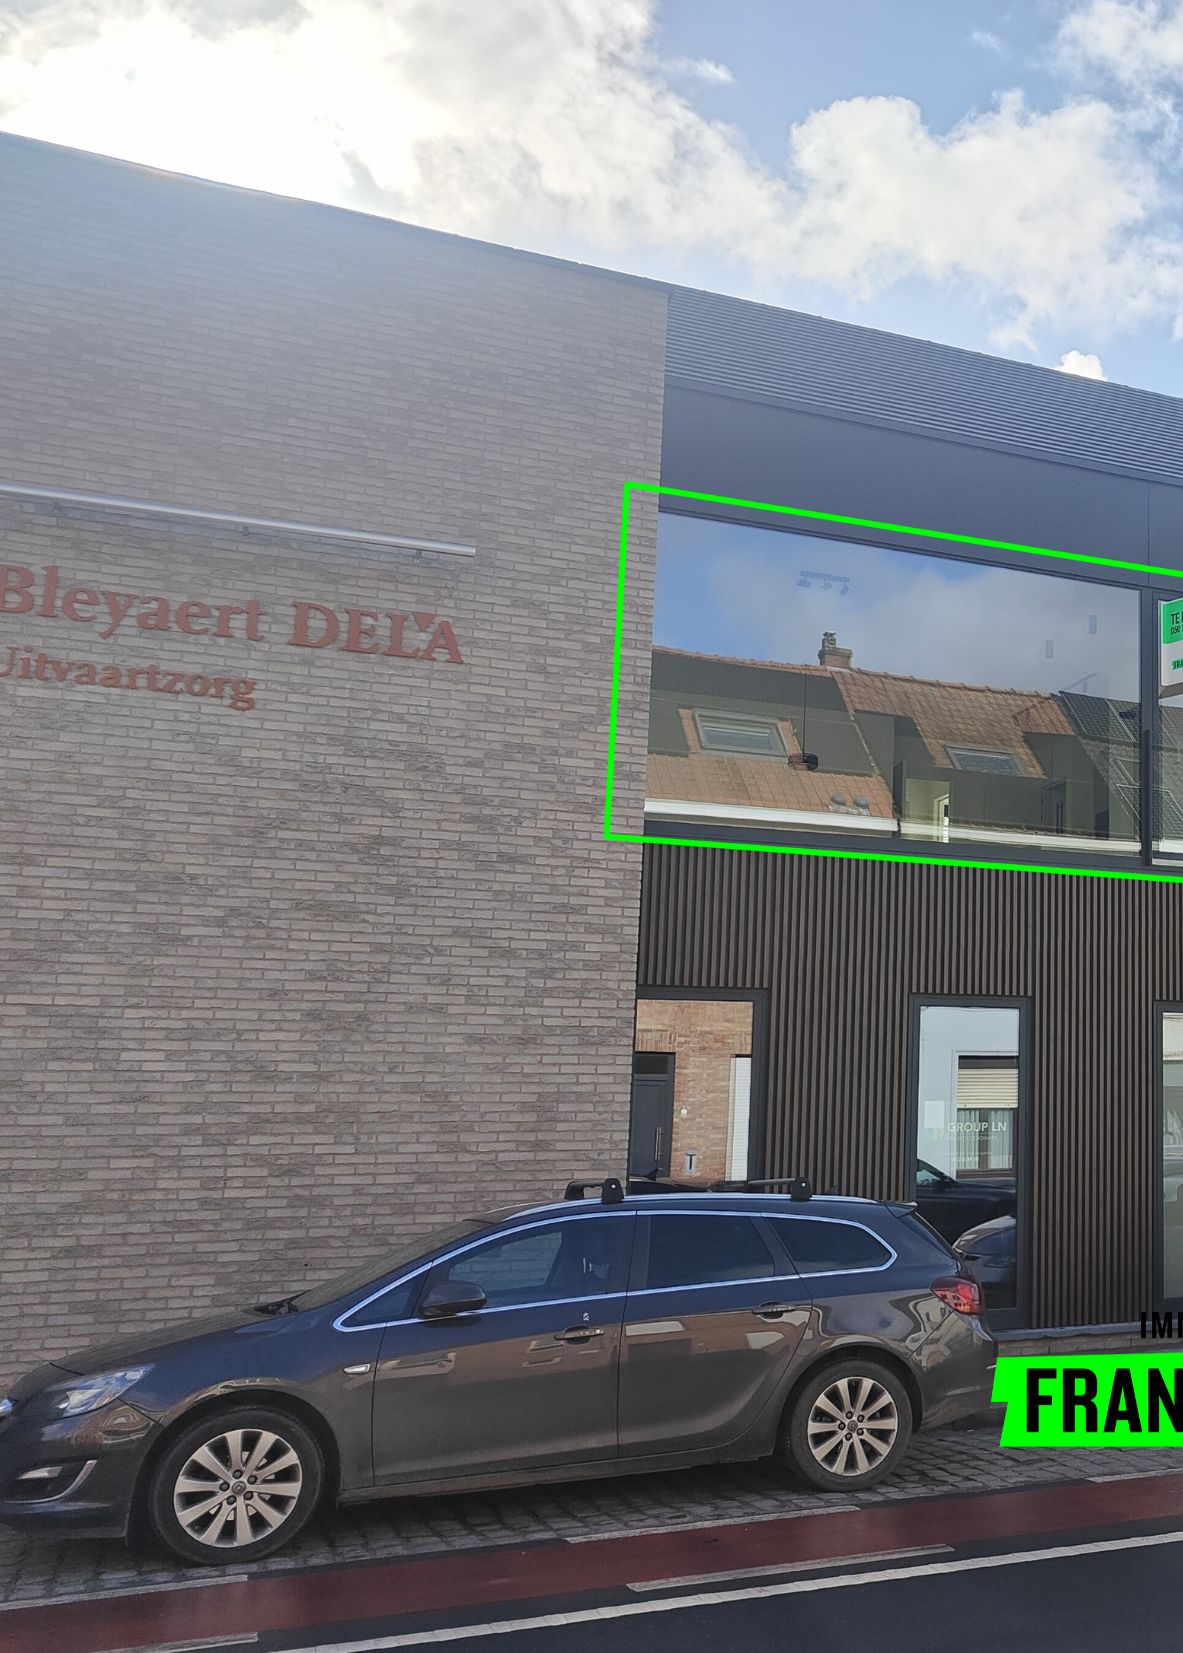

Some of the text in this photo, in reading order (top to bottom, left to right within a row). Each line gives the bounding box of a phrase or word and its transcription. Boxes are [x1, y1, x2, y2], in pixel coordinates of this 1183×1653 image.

[0, 563, 464, 664] Bleyaert DELA
[1171, 612, 1180, 625] TE
[947, 1121, 1007, 1132] GROUP LN
